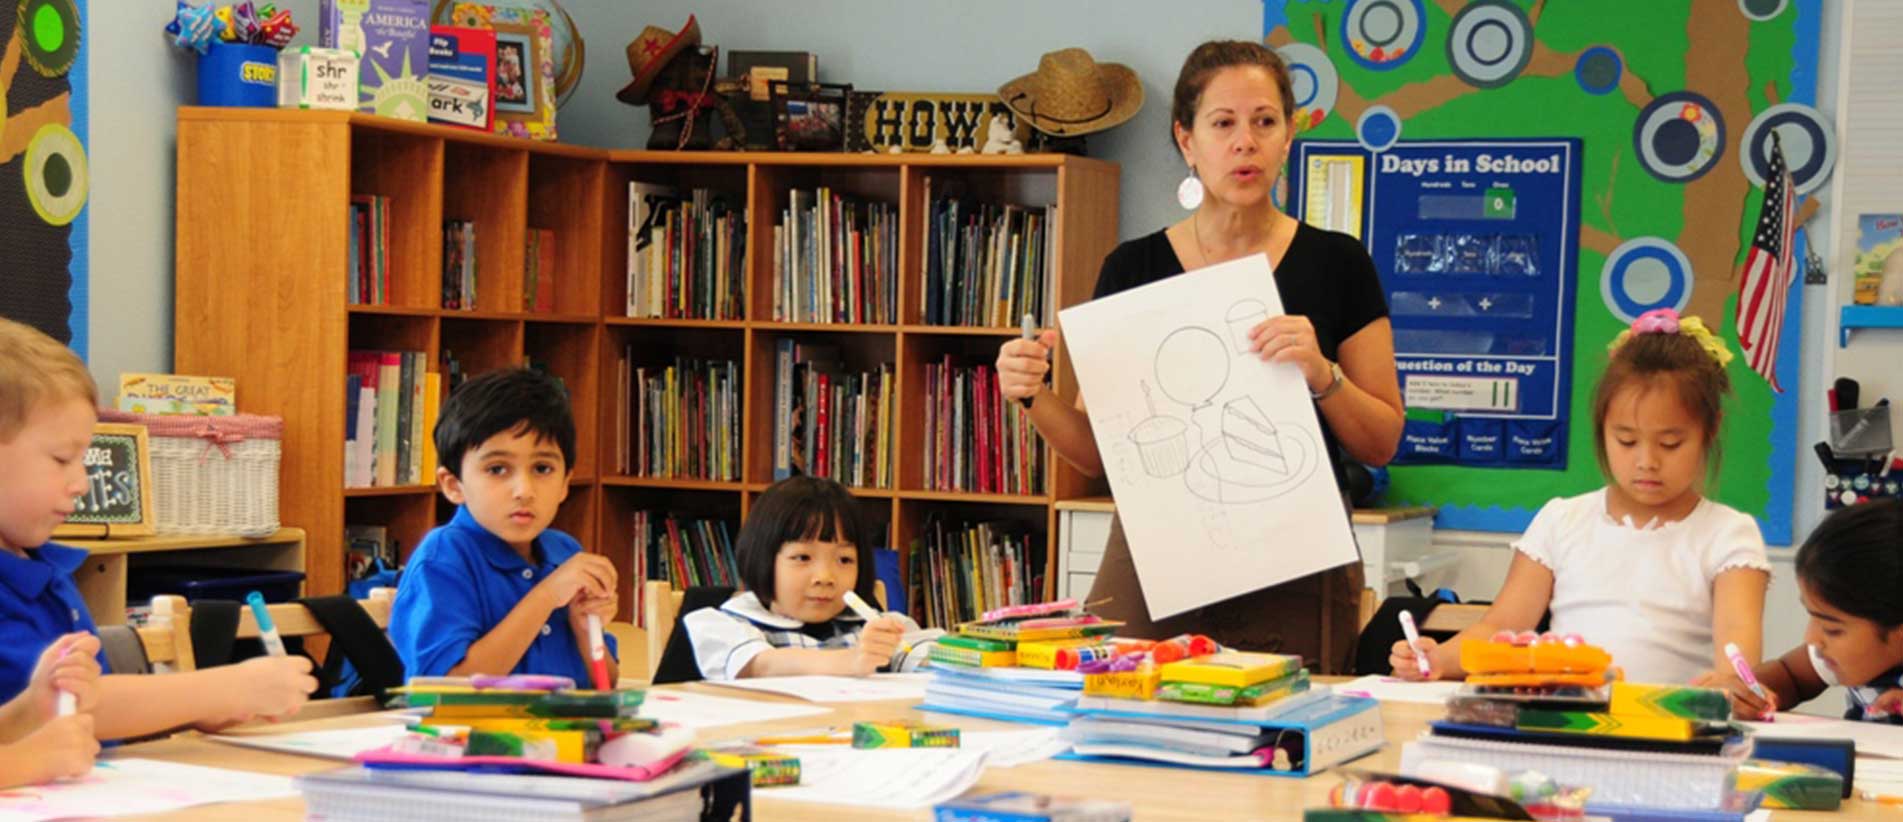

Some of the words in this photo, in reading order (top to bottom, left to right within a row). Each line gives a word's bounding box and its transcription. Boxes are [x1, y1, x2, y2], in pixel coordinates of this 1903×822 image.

[366, 13, 427, 30] AMERICA
[316, 60, 347, 79] shr
[430, 97, 463, 115] ark
[1381, 154, 1439, 177] Days
[1444, 154, 1470, 173] in
[1475, 154, 1560, 173] School
[1494, 197, 1504, 211] 0
[1396, 360, 1453, 371] uestion
[1456, 360, 1473, 372] of
[1476, 361, 1502, 372] the
[1505, 361, 1536, 375] Day
[147, 384, 170, 395] THE
[174, 385, 210, 396] GREAT
[1466, 434, 1498, 443] Number
[1471, 443, 1494, 452] Cards
[1520, 446, 1543, 455] Cards
[76, 470, 131, 512] TES
